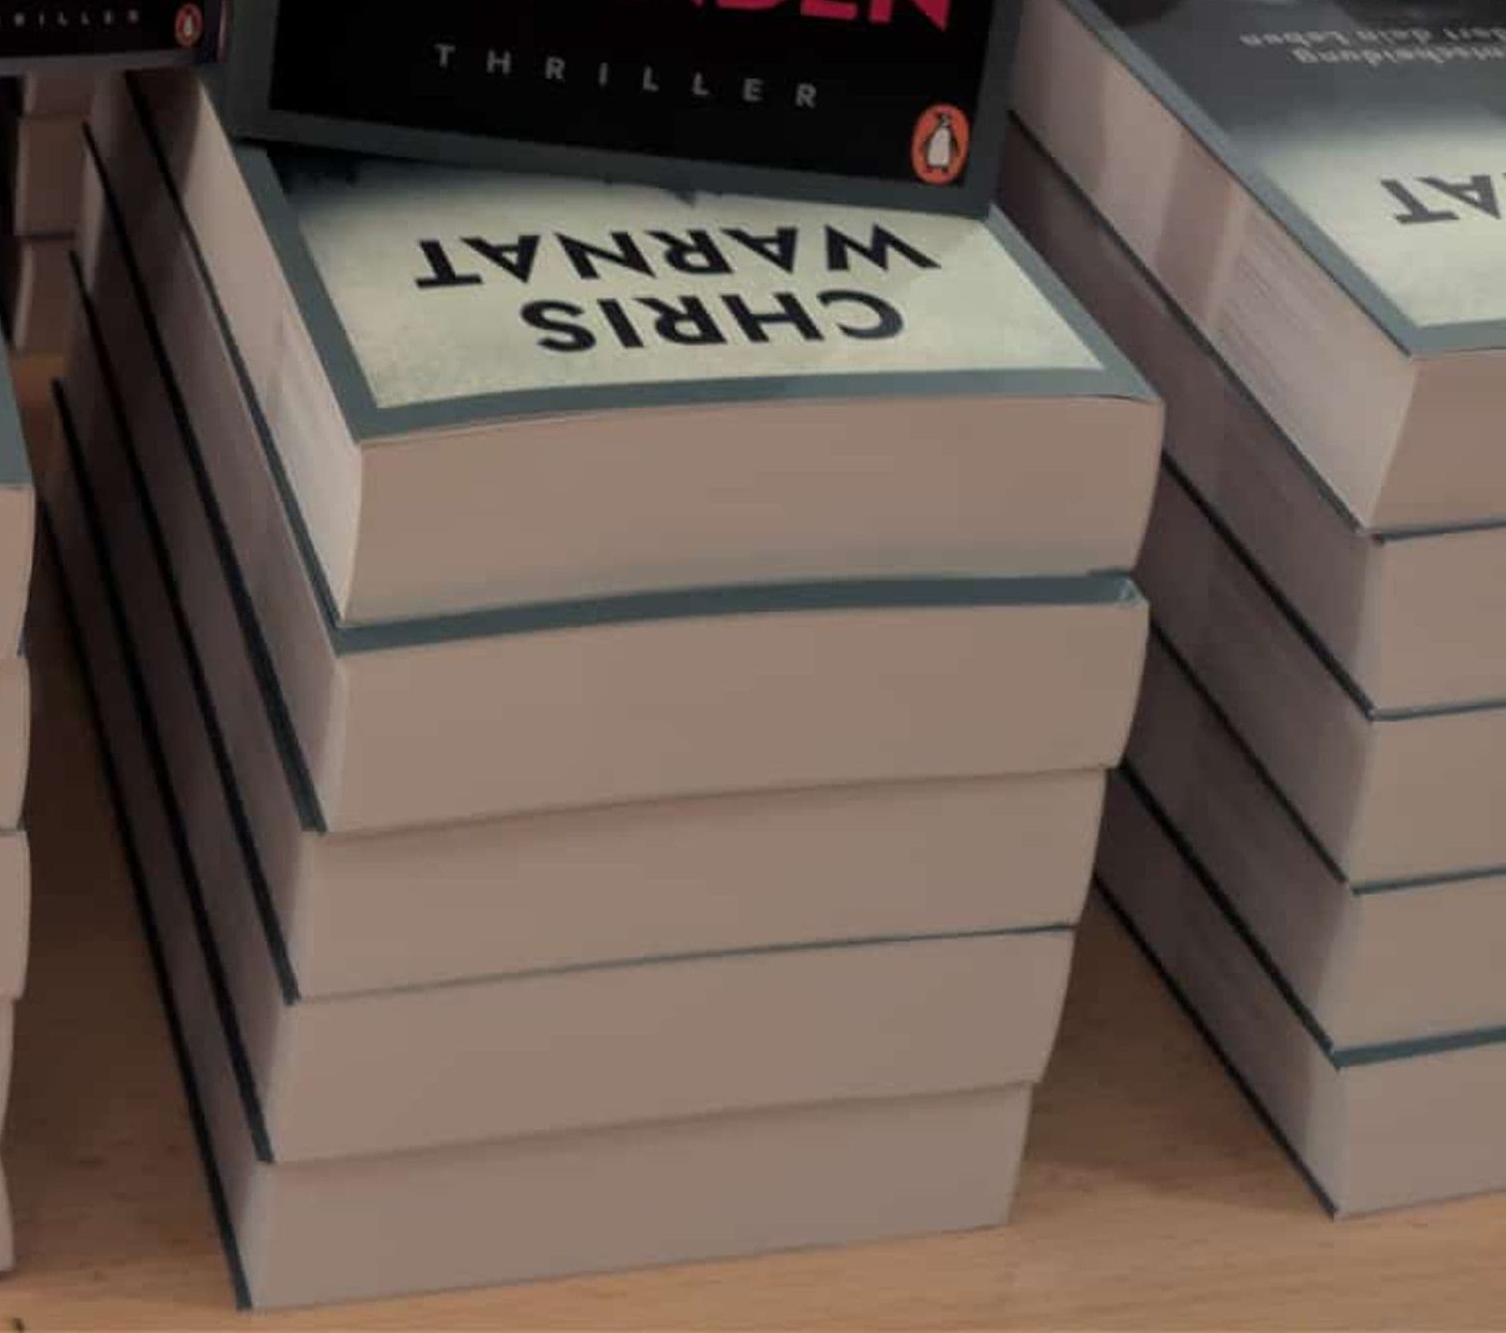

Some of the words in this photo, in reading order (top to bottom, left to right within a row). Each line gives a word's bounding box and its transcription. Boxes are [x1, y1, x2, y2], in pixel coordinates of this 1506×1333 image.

[434, 42, 819, 108] THRILLER
[416, 223, 943, 289] WARNAT
[520, 290, 905, 354] CHRIS
